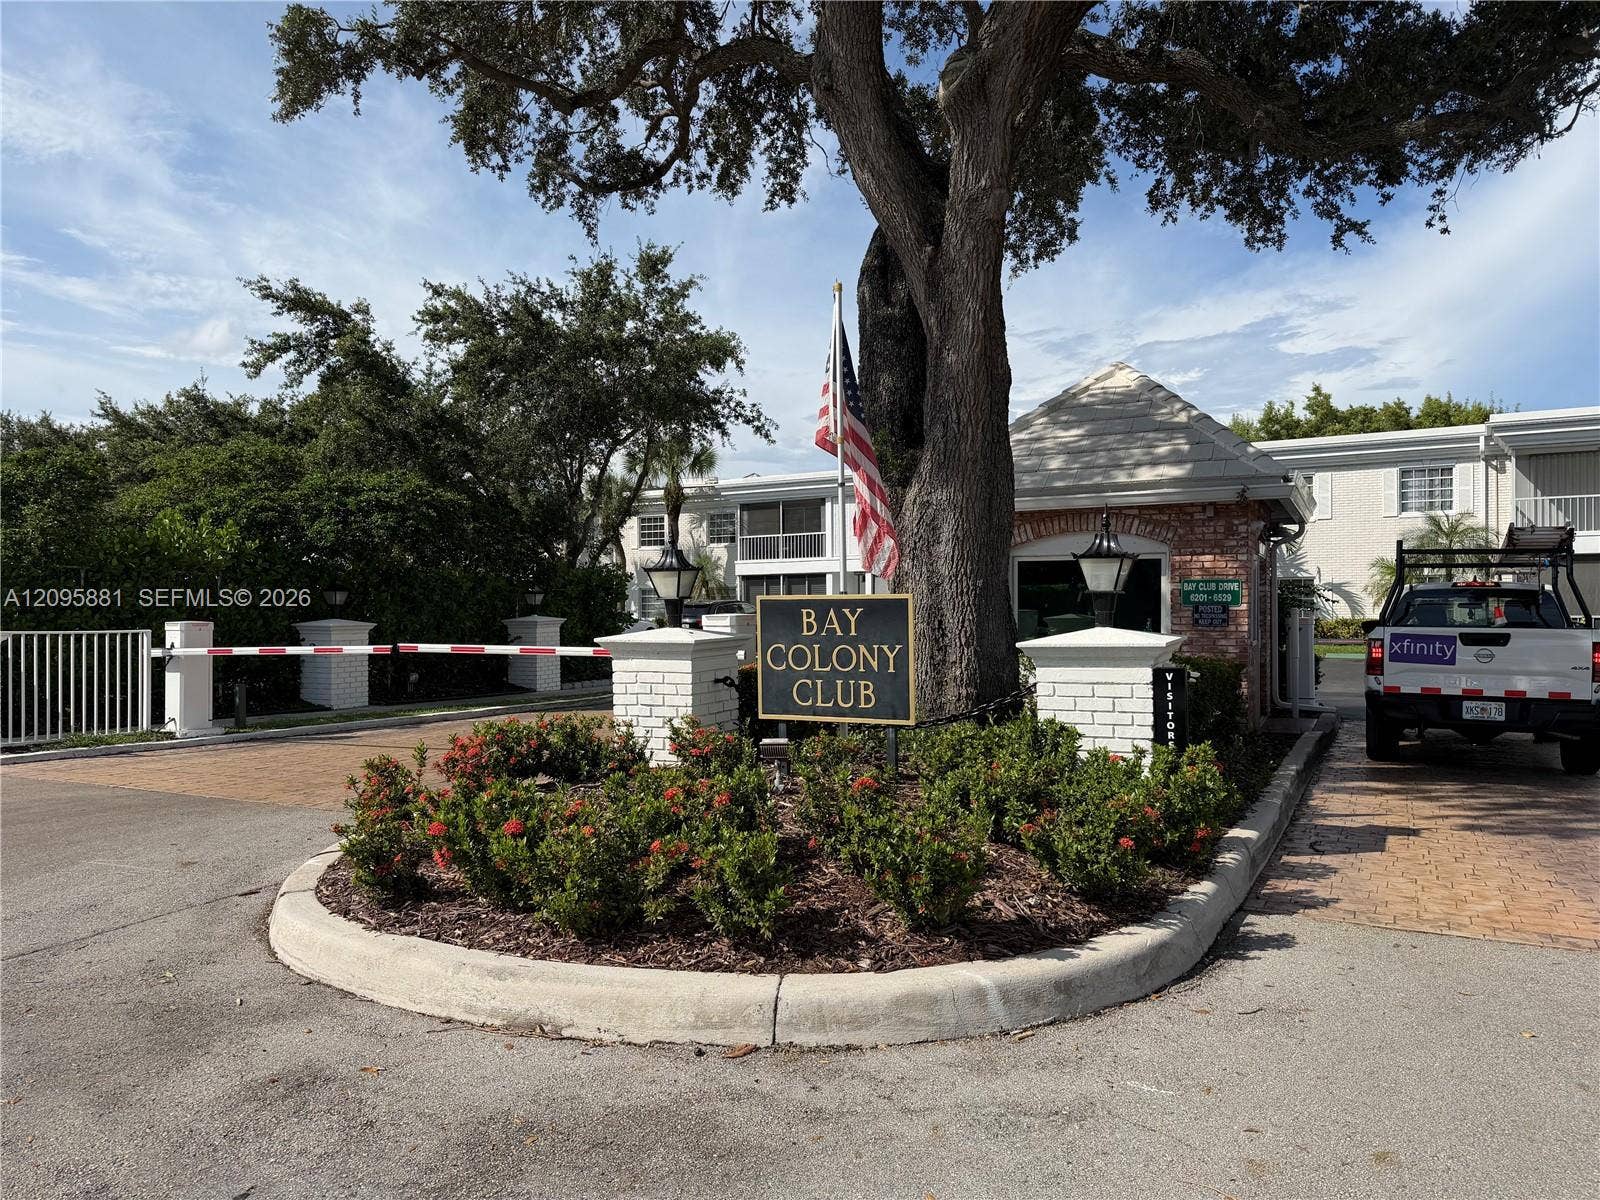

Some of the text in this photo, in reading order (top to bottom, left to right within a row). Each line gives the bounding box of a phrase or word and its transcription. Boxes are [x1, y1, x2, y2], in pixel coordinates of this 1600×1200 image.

[1183, 582, 1240, 591] BAY CLUB DRIVE
[1190, 593, 1208, 602] 6201
[1213, 593, 1232, 602] 6529
[1198, 605, 1223, 613] POSTED
[800, 607, 864, 636] BAY
[766, 643, 903, 673] COLONY
[1390, 638, 1455, 660] xfinity
[792, 679, 876, 708] CLUB
